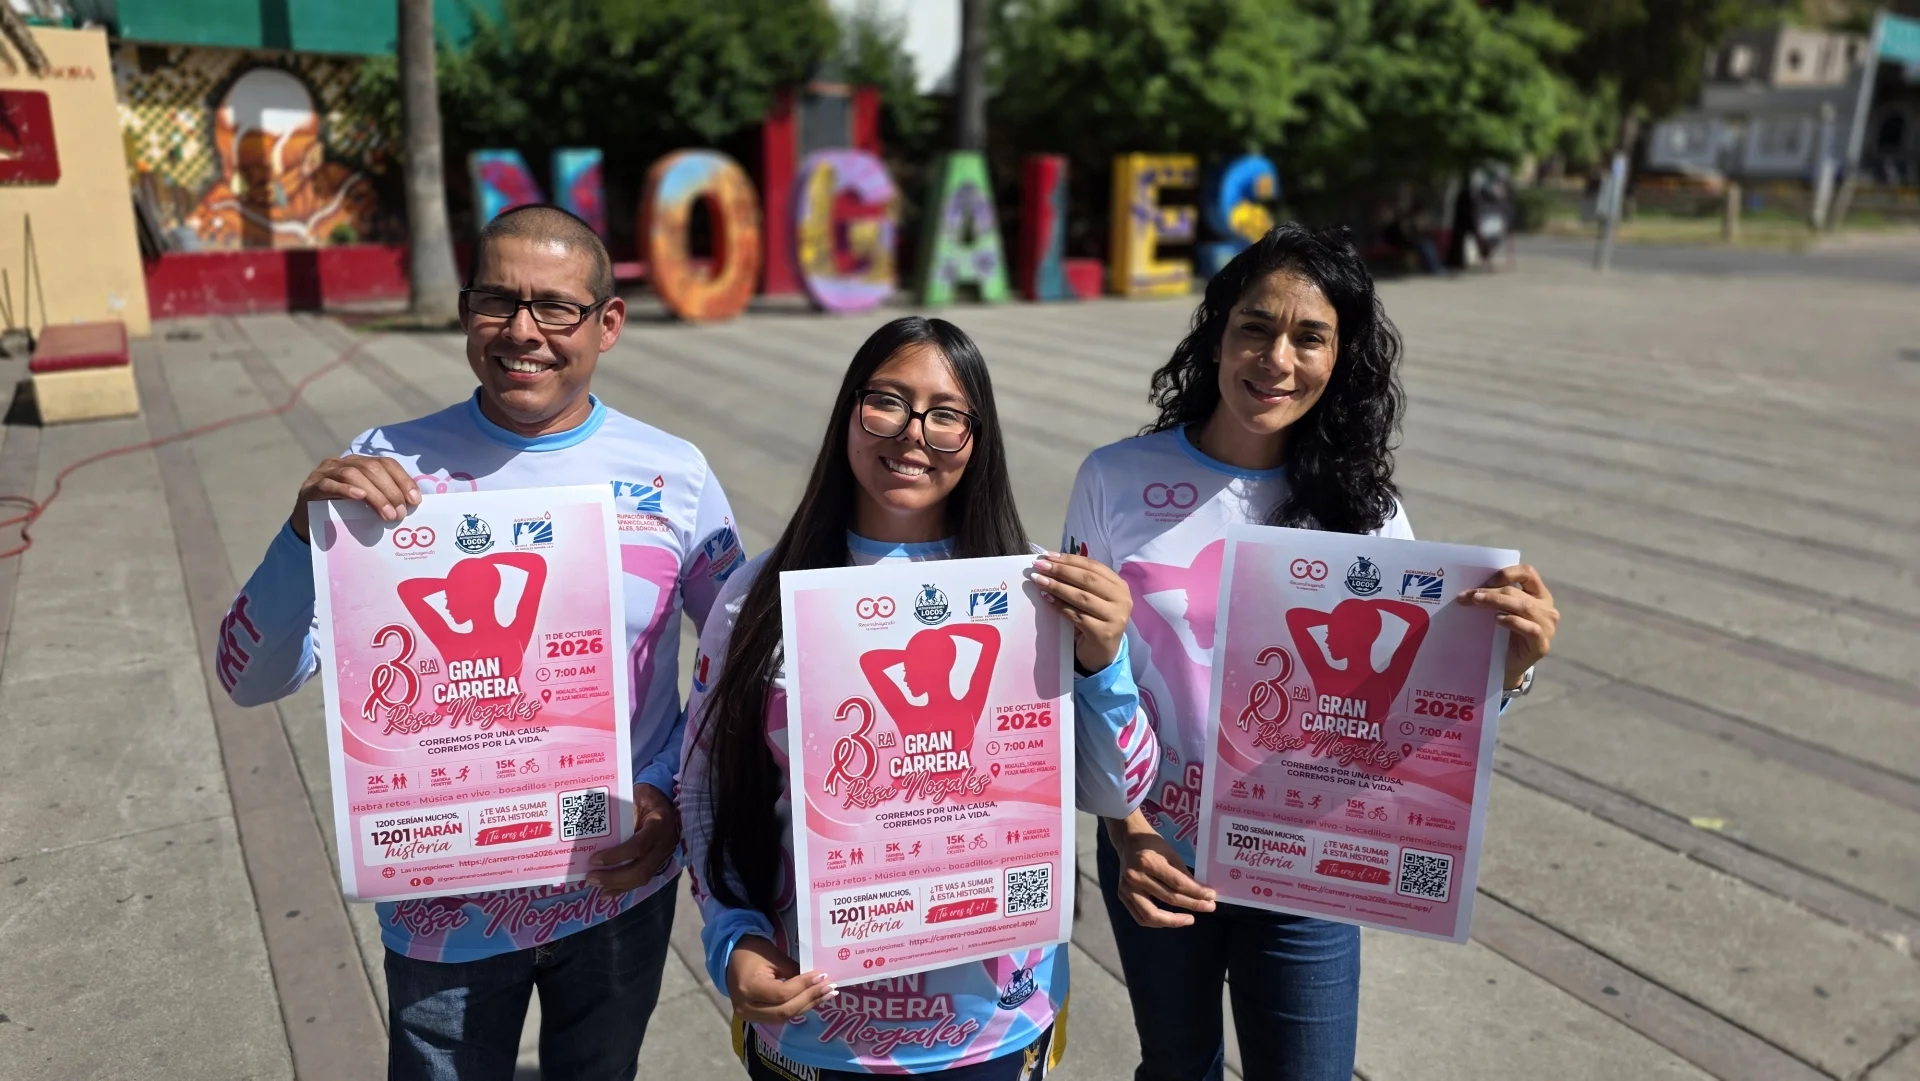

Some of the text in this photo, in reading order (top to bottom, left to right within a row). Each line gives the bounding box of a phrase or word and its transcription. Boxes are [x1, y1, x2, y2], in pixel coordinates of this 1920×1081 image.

[462, 538, 487, 546] LOCOS
[1352, 580, 1375, 588] LOCOS
[921, 609, 943, 617] LOCOS
[552, 632, 563, 640] DE
[564, 629, 602, 639] OCTUBRE
[546, 637, 603, 658] 2026
[448, 657, 500, 681] GRAN
[555, 665, 596, 678] 7:00 AM
[433, 677, 520, 704] CARRERA
[1423, 690, 1433, 698] DE
[1435, 692, 1475, 703] OCTUBRE
[382, 692, 541, 735] Rosa Nogales
[996, 702, 1051, 714] 11 DE OCTUBRE
[1318, 694, 1367, 719] GRAN
[1414, 698, 1475, 721] 2026
[996, 711, 1052, 731] 2026
[1301, 713, 1381, 741] CARRERA
[419, 726, 549, 747] CORREMOS POR UNA CAUSA,
[904, 730, 953, 755] GRAN
[1418, 726, 1462, 741] 7:00 AM
[427, 735, 542, 755] CORREMOS POR LA VIDA.
[1004, 739, 1044, 752] 7:00 AM
[1252, 721, 1399, 769] Rosa Nogales
[431, 768, 446, 778] 5K
[495, 759, 516, 769] 15K
[889, 750, 970, 778] CARRERA
[1281, 759, 1403, 786] CORREMOS POR UNA CAUSA,
[367, 775, 384, 785] 2K
[842, 766, 990, 808] Rosa Nogales
[1232, 780, 1246, 789] 2K
[1287, 769, 1395, 793] CORREMOS POR LA VIDA.
[352, 773, 615, 813] Habrá retos Música en vivo bocadillos premiaciones
[1286, 789, 1301, 799] 5K
[480, 801, 547, 817] ¿TE VAS A SUMAR
[875, 801, 998, 820] CORREMOS POR UNA CAUSA,
[1346, 799, 1366, 810] 15K
[375, 812, 459, 828] 1200 SERÍAN MUCHOS,
[480, 809, 549, 825] A ESTA HISTORIA?
[883, 810, 990, 829] CORREMOS POR LA VIDA.
[371, 820, 463, 846] 1201 HARÁN
[946, 834, 965, 845] 15K
[1231, 823, 1305, 842] 1200 SERÍAN MUCHOS,
[384, 838, 452, 860] historia
[885, 843, 900, 852] 5K
[1226, 832, 1306, 857] 1201 HARÁN
[827, 850, 843, 860] 2K
[1234, 846, 1294, 869] historia
[412, 863, 455, 874] inscripciones:
[813, 849, 1059, 889] Habrá retos Música en vivo bocadillos premiaciones
[929, 886, 995, 902] A ESTA HISTORIA?
[930, 884, 944, 894] ¿TE
[945, 882, 959, 891] VAS
[967, 877, 993, 888] SUMAR
[833, 888, 911, 906] 1200 SERÍAN MUCHOS,
[829, 898, 914, 925] 1201 HARÁN
[949, 908, 964, 918] eres
[966, 902, 974, 916] el
[841, 917, 904, 940] historia
[866, 942, 905, 953] inscripciones:
[909, 918, 1038, 946] https://carrera-rosa2026.vercel.app/
[818, 992, 949, 1019] ARRERA
[818, 1008, 979, 1057] Nogales
